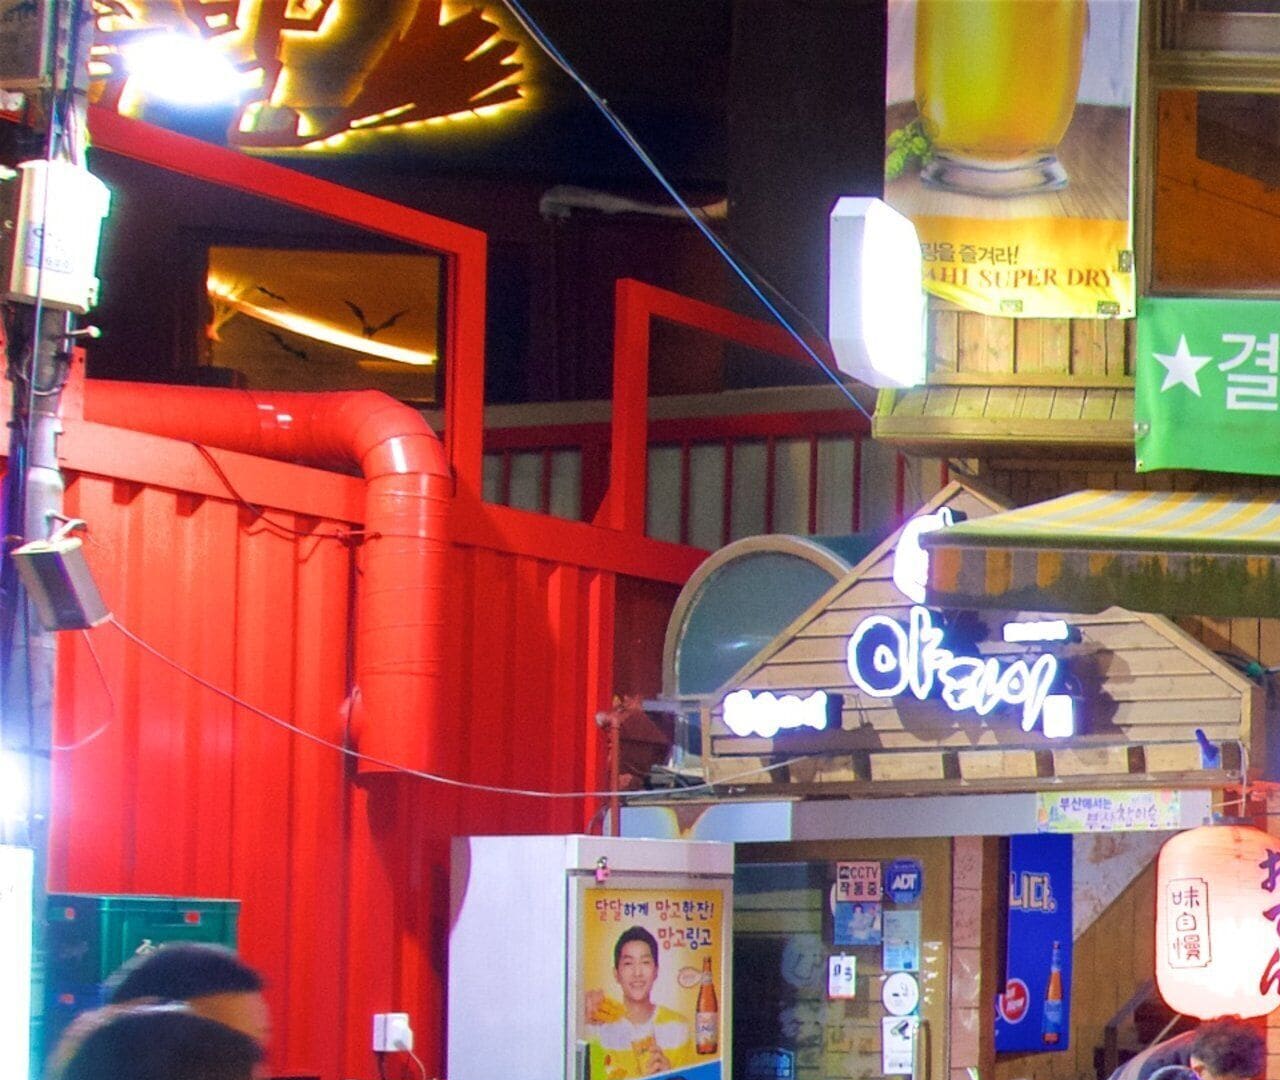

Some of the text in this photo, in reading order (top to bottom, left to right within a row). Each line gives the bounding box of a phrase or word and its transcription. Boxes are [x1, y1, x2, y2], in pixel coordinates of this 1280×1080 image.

[959, 244, 1020, 265] 즐겨라!
[924, 266, 1113, 288] AHI SUPER DRY
[849, 866, 879, 879] CCTV
[891, 873, 918, 890] ADT
[657, 927, 713, 950] 망고링고
